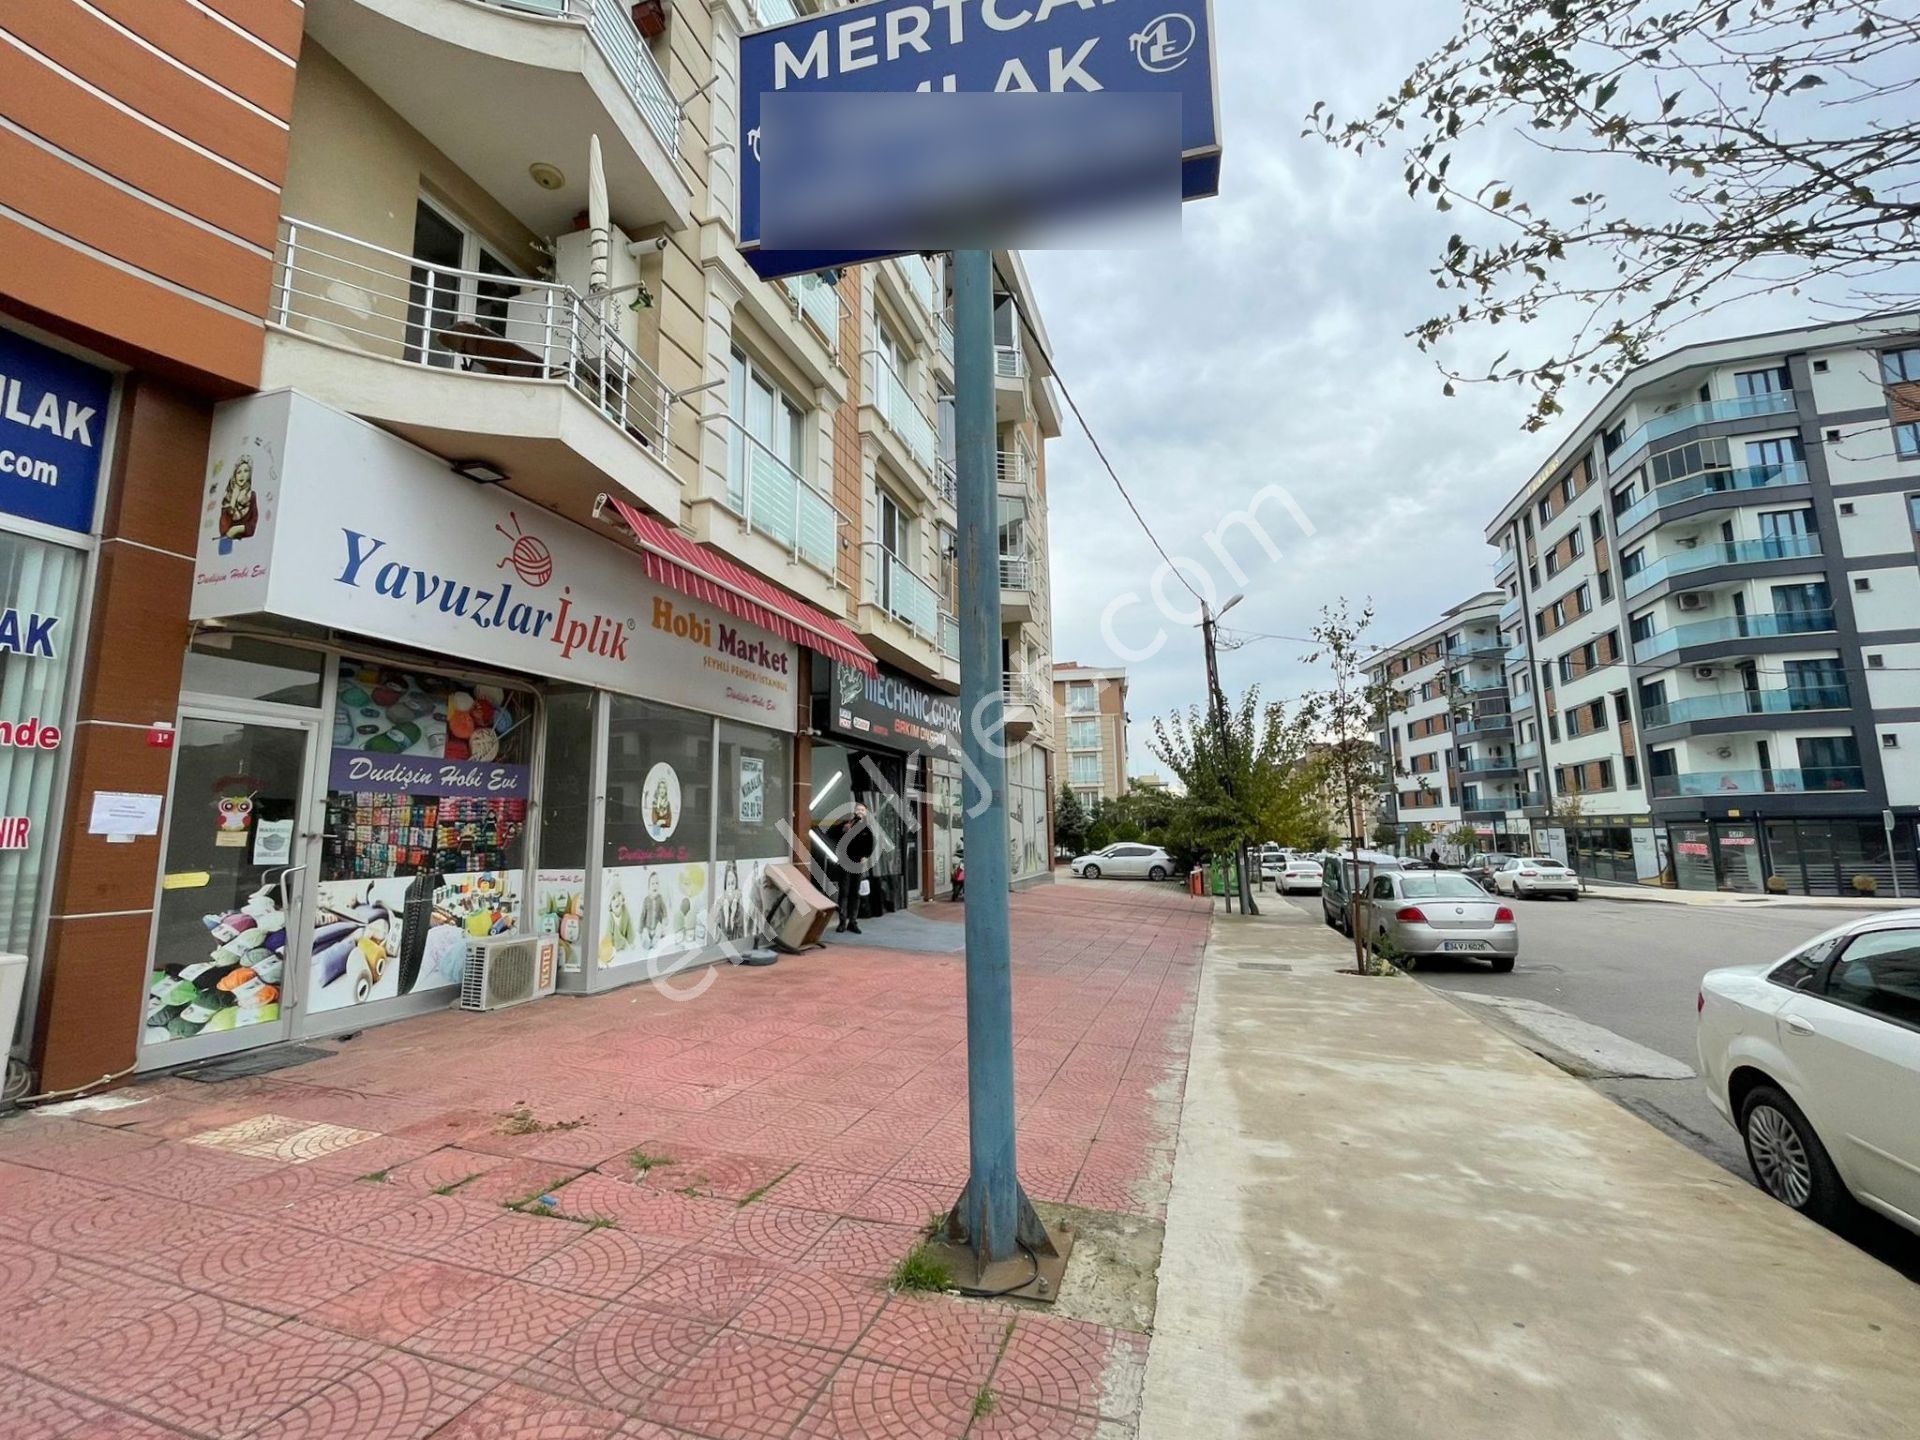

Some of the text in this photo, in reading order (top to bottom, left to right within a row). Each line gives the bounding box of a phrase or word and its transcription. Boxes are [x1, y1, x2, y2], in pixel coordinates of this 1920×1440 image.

[652, 596, 788, 675] Hobi Market
[349, 757, 519, 791] Dudişin Hobi Evi
[539, 944, 554, 989] VESTEL
